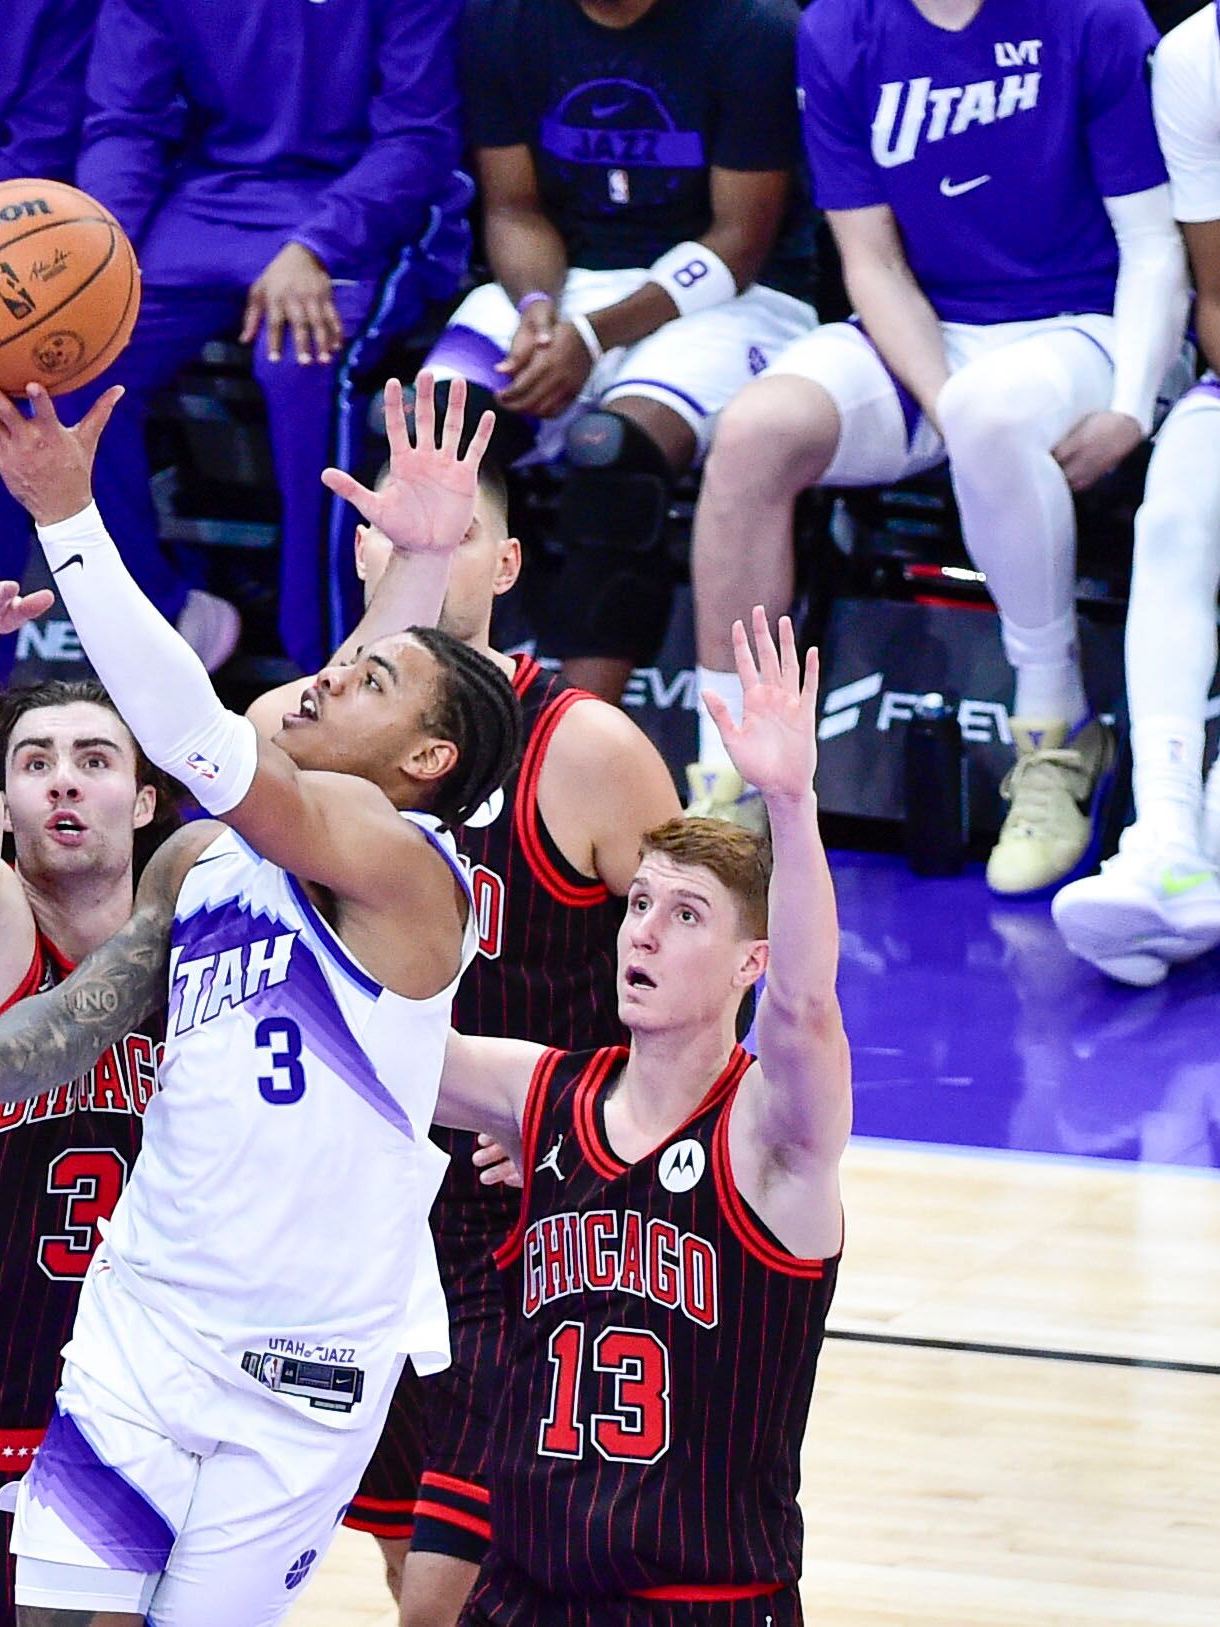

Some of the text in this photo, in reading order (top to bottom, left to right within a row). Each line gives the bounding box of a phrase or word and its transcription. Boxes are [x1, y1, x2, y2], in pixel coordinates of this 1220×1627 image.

[994, 39, 1043, 67] LVT
[871, 72, 1042, 168] UTAH
[255, 1016, 307, 1106] 3
[522, 1209, 719, 1330] CHICAGO
[268, 1337, 305, 1357] UTAH
[537, 1320, 670, 1466] 13
